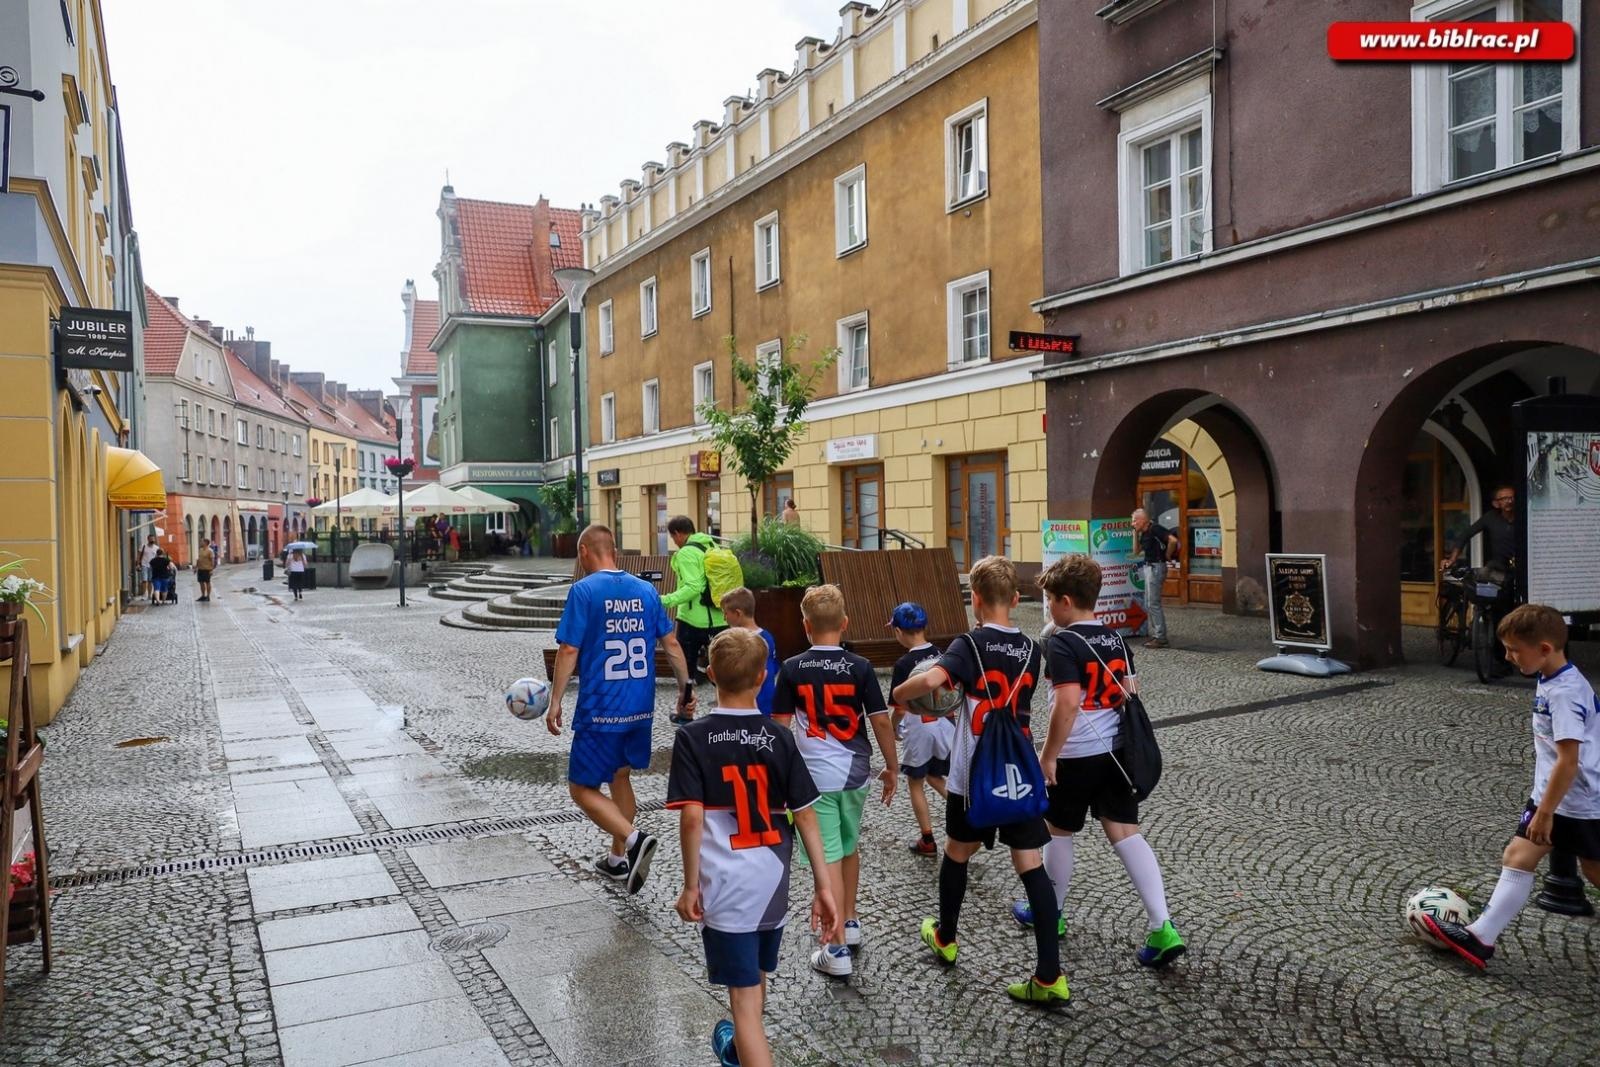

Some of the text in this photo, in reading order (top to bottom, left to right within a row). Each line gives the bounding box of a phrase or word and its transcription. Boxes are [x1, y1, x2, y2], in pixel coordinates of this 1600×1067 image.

[67, 320, 126, 334] JUBILER
[1141, 460, 1180, 470] OKUMENTY
[1111, 530, 1135, 538] CYFRO
[1100, 563, 1134, 571] OKUMENTÓW
[604, 599, 644, 614] PAWEŁ
[606, 616, 645, 633] SKÓRA
[1096, 611, 1126, 625] FOTO
[604, 637, 648, 680] 28
[797, 684, 860, 742] 15
[721, 764, 782, 851] 11
